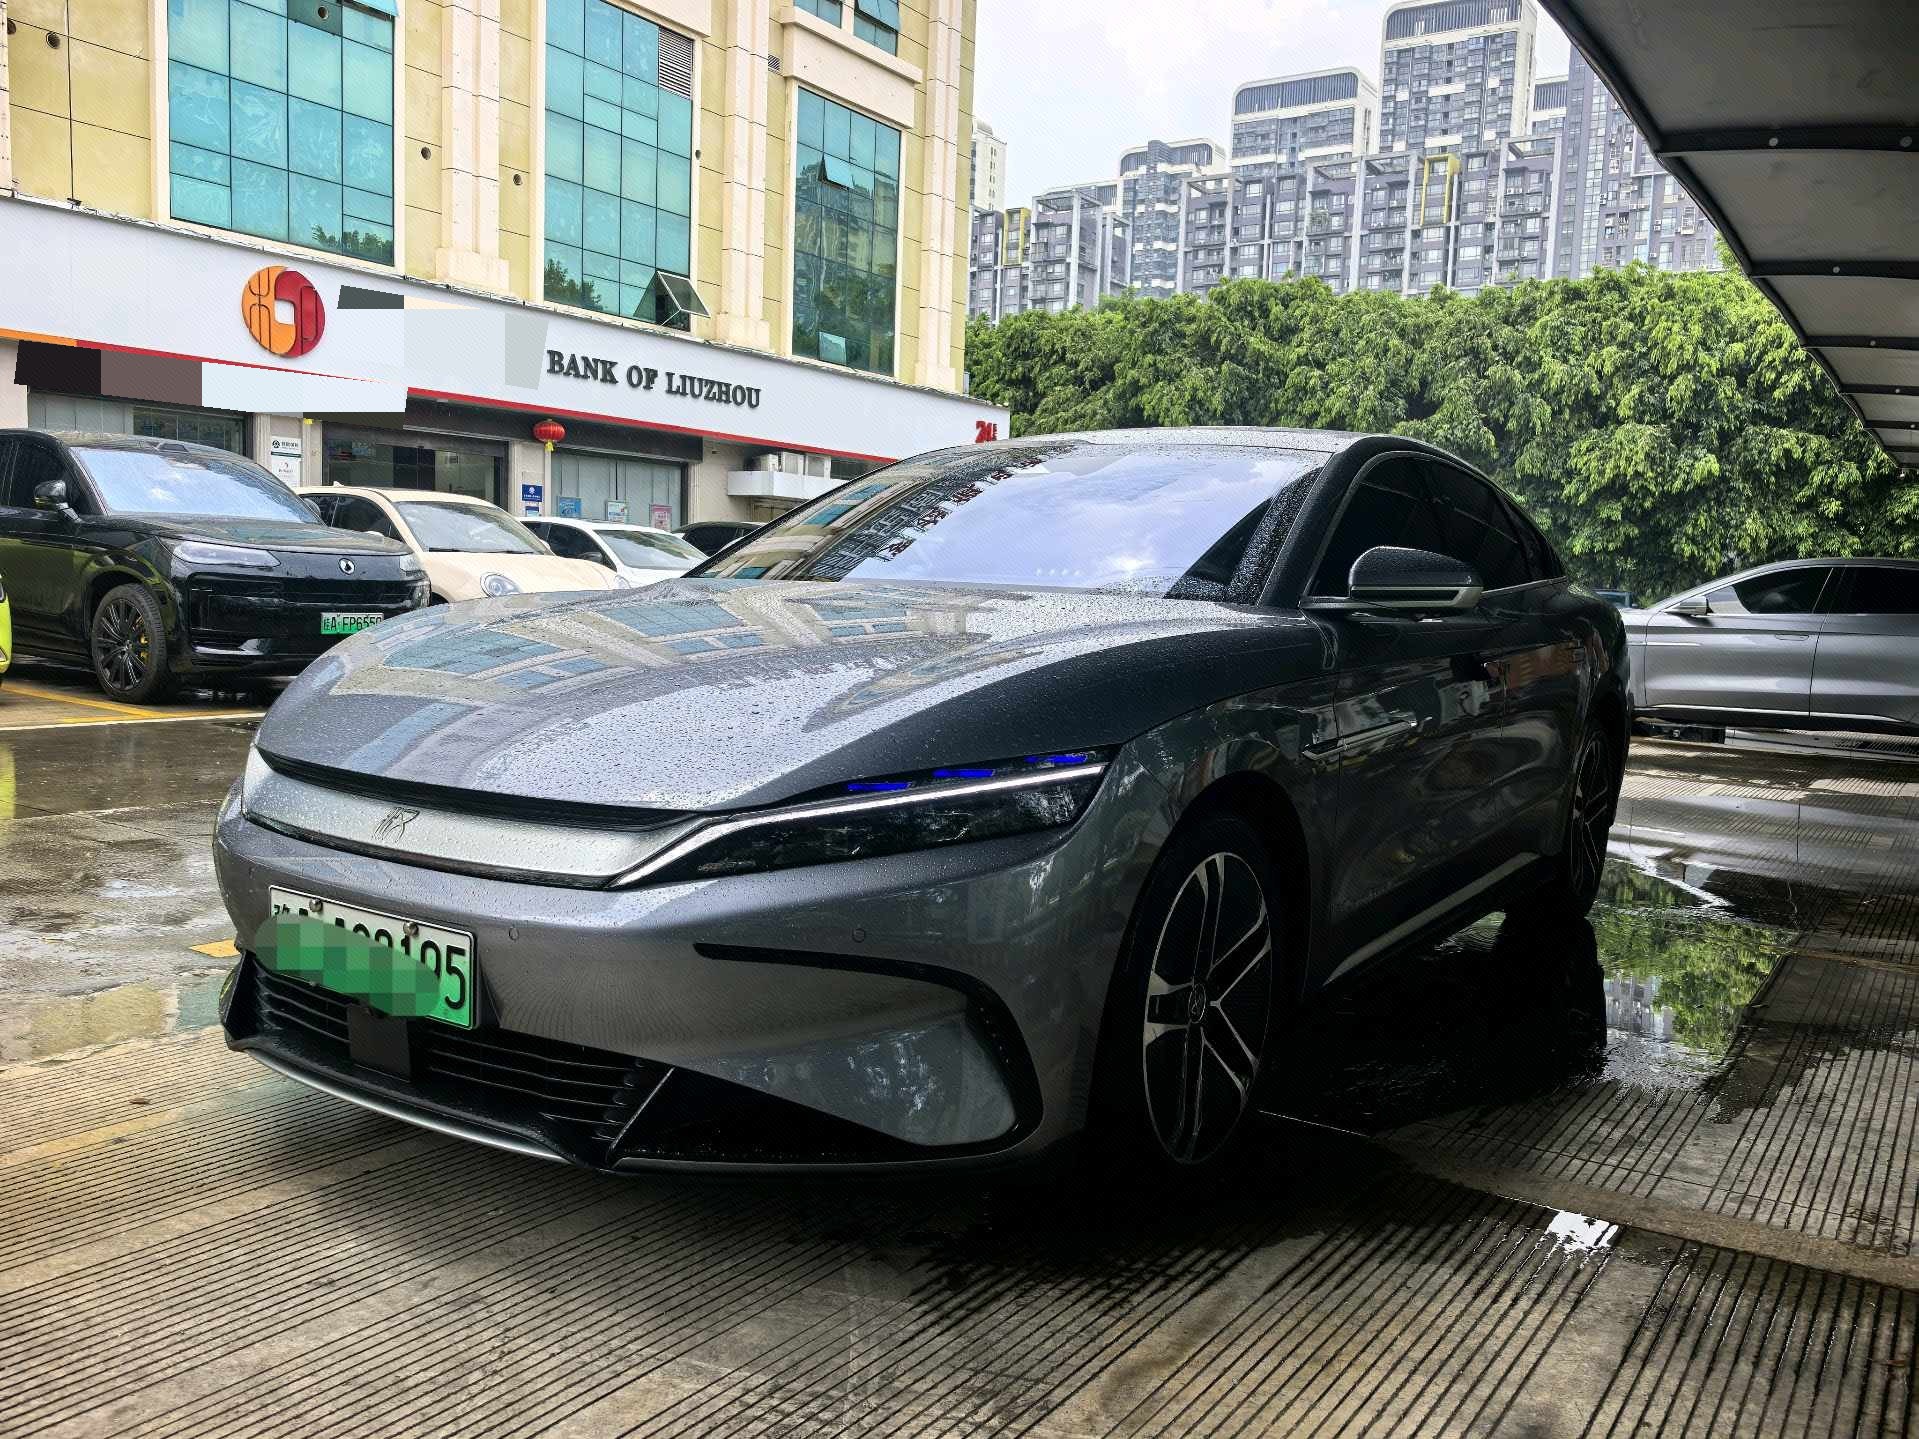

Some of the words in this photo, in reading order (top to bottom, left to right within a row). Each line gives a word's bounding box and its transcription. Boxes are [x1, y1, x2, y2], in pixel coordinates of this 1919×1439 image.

[547, 350, 619, 384] BANK
[626, 365, 659, 390] OF
[665, 371, 761, 409] LIUZHOU
